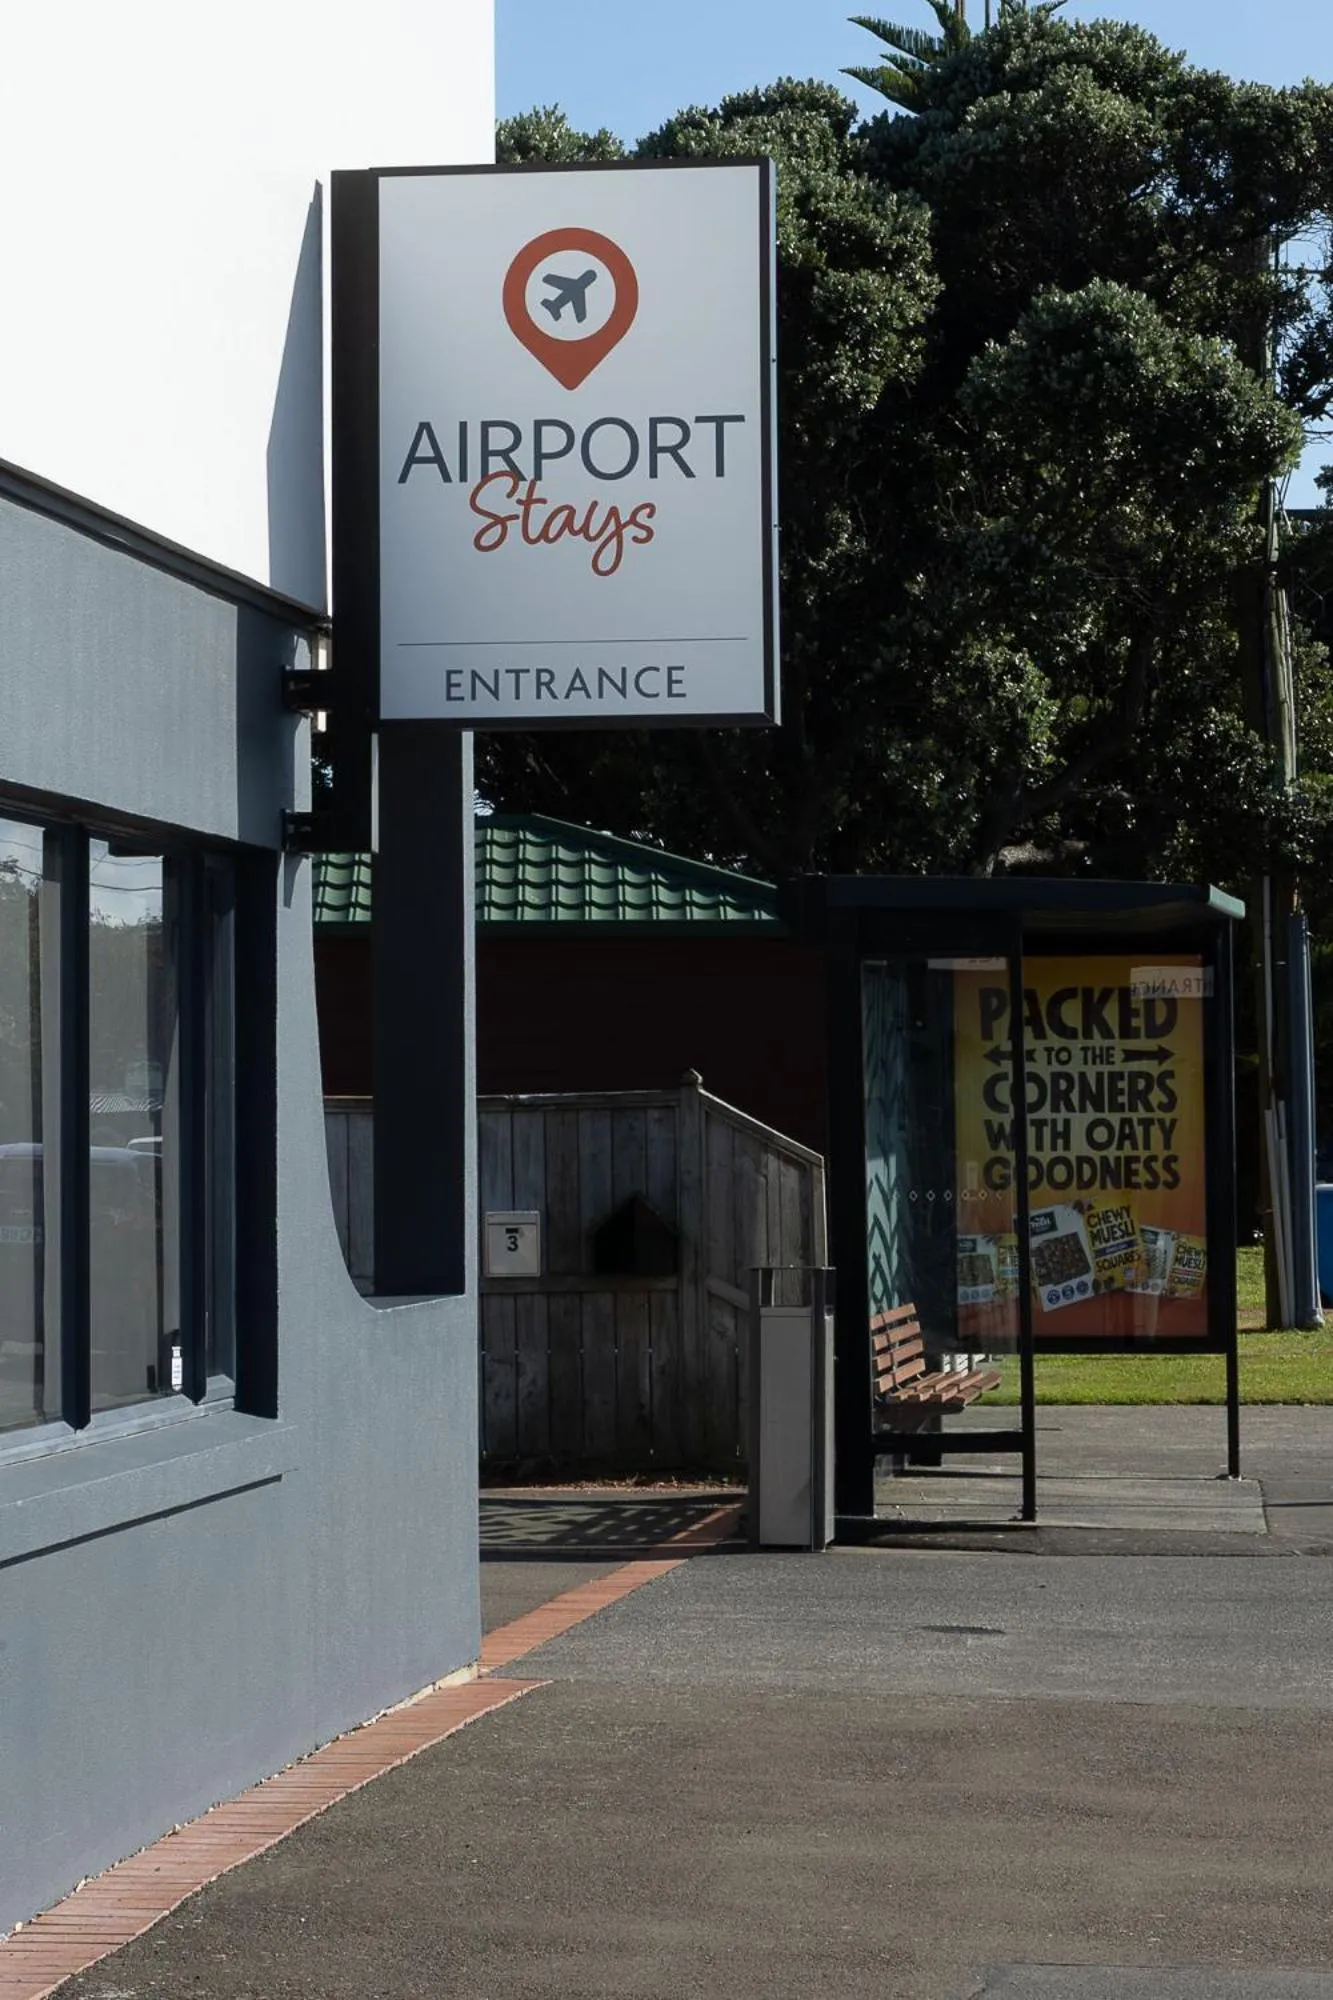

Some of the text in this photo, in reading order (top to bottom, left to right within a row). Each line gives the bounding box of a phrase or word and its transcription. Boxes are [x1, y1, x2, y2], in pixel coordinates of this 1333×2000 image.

[397, 415, 745, 484] AIRPORT
[470, 470, 656, 577] Stays
[445, 666, 687, 702] ENTRANCE
[980, 987, 1177, 1040] PACKED
[1044, 1046, 1116, 1065] TO THE
[983, 1070, 1178, 1113] CORNERS
[984, 1118, 1178, 1152] WTH OATY
[984, 1154, 1180, 1191] GOODNESS
[1087, 1204, 1132, 1228] CHEWY
[1090, 1218, 1136, 1247] MUESLI
[507, 1235, 518, 1251] 3
